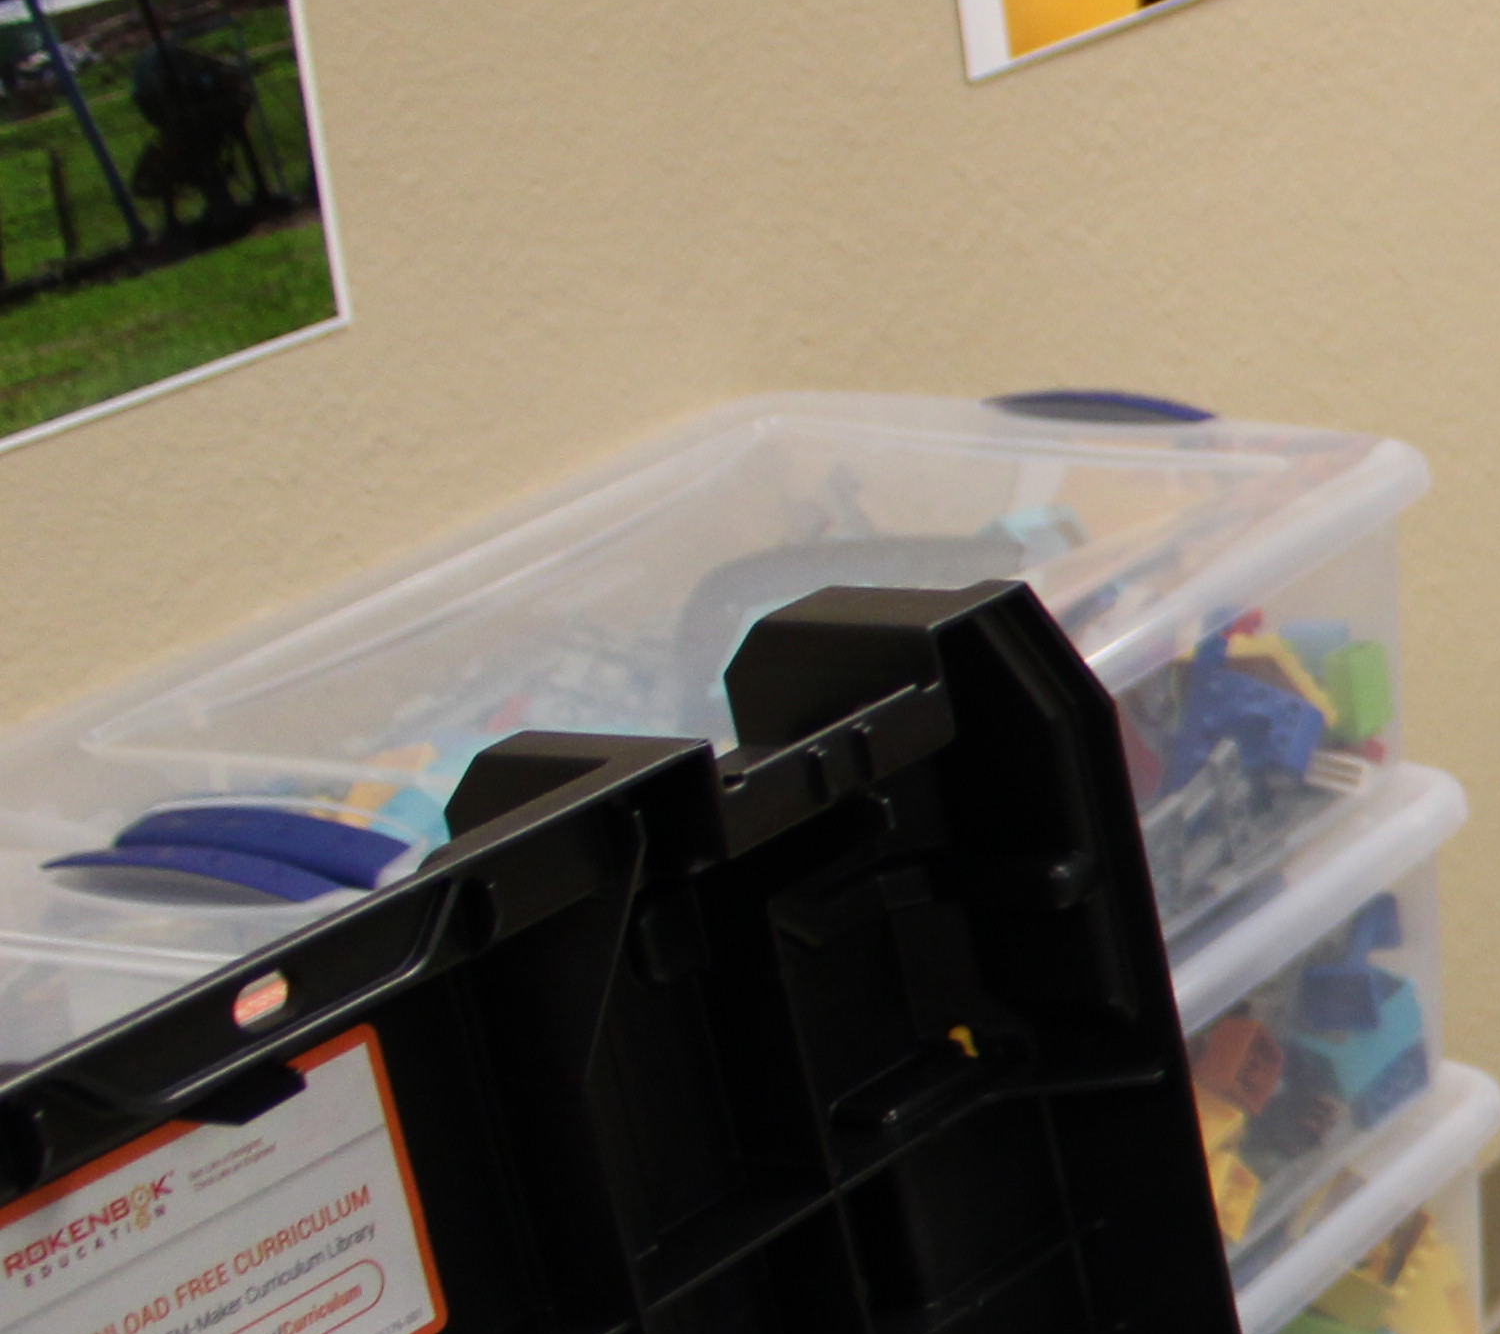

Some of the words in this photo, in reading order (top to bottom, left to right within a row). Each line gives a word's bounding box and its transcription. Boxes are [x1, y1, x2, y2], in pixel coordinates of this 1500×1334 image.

[3, 1172, 173, 1278] ROKENBOK
[176, 1263, 230, 1309] FREE
[233, 1185, 371, 1275] CURRICULUM
[246, 1247, 327, 1305] Curriculum
[327, 1222, 376, 1261] Library
